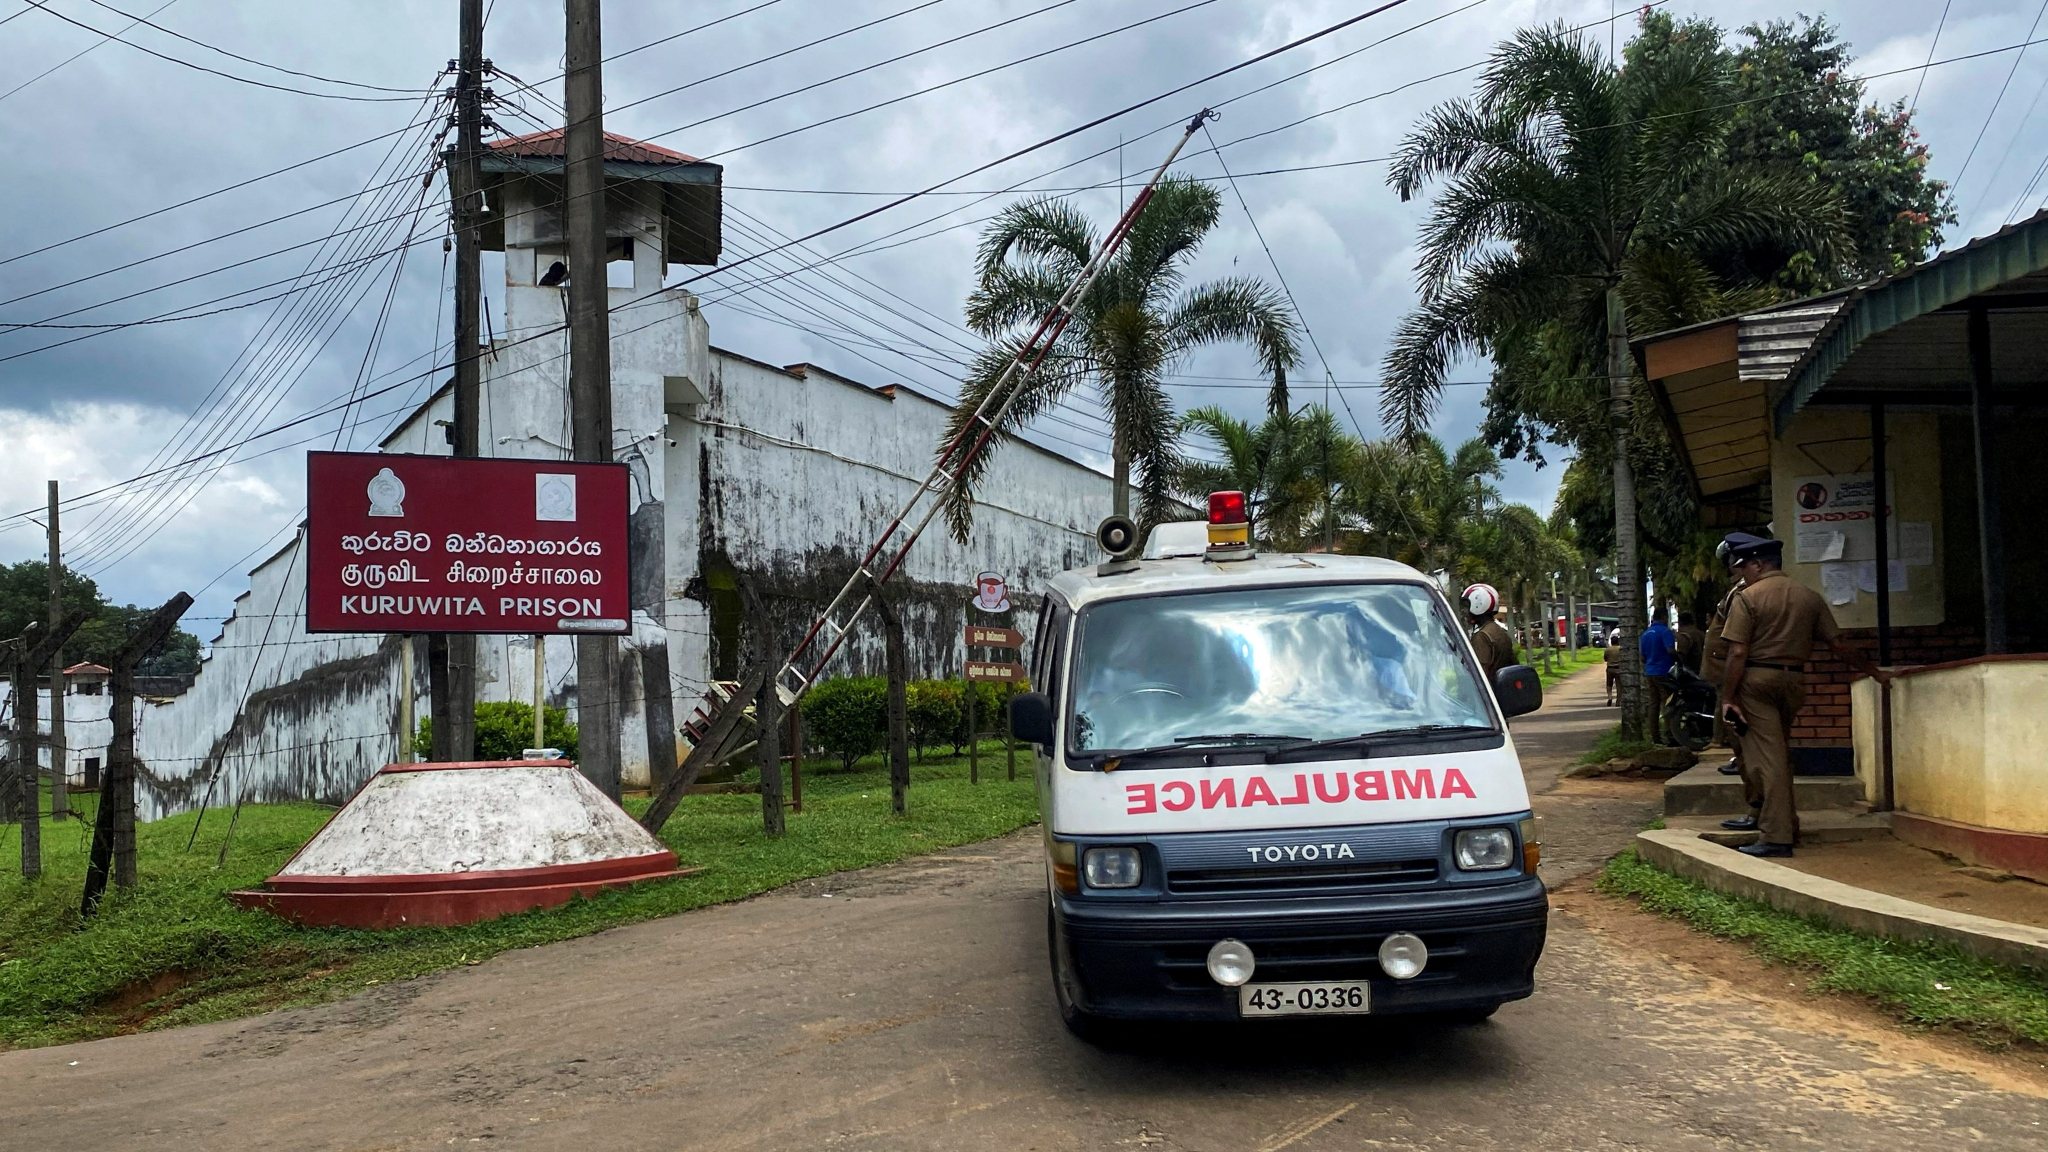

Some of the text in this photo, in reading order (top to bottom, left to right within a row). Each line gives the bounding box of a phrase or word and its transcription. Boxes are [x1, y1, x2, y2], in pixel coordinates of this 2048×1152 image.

[341, 530, 602, 556] කුරුවිට බන්ධනාගාරය
[341, 558, 602, 590] குருவிட சிறைச்சாலை
[341, 595, 602, 617] KURUWITA PRISON
[1246, 843, 1355, 863] TOYOTA
[1249, 986, 1363, 1010] 43-0336
